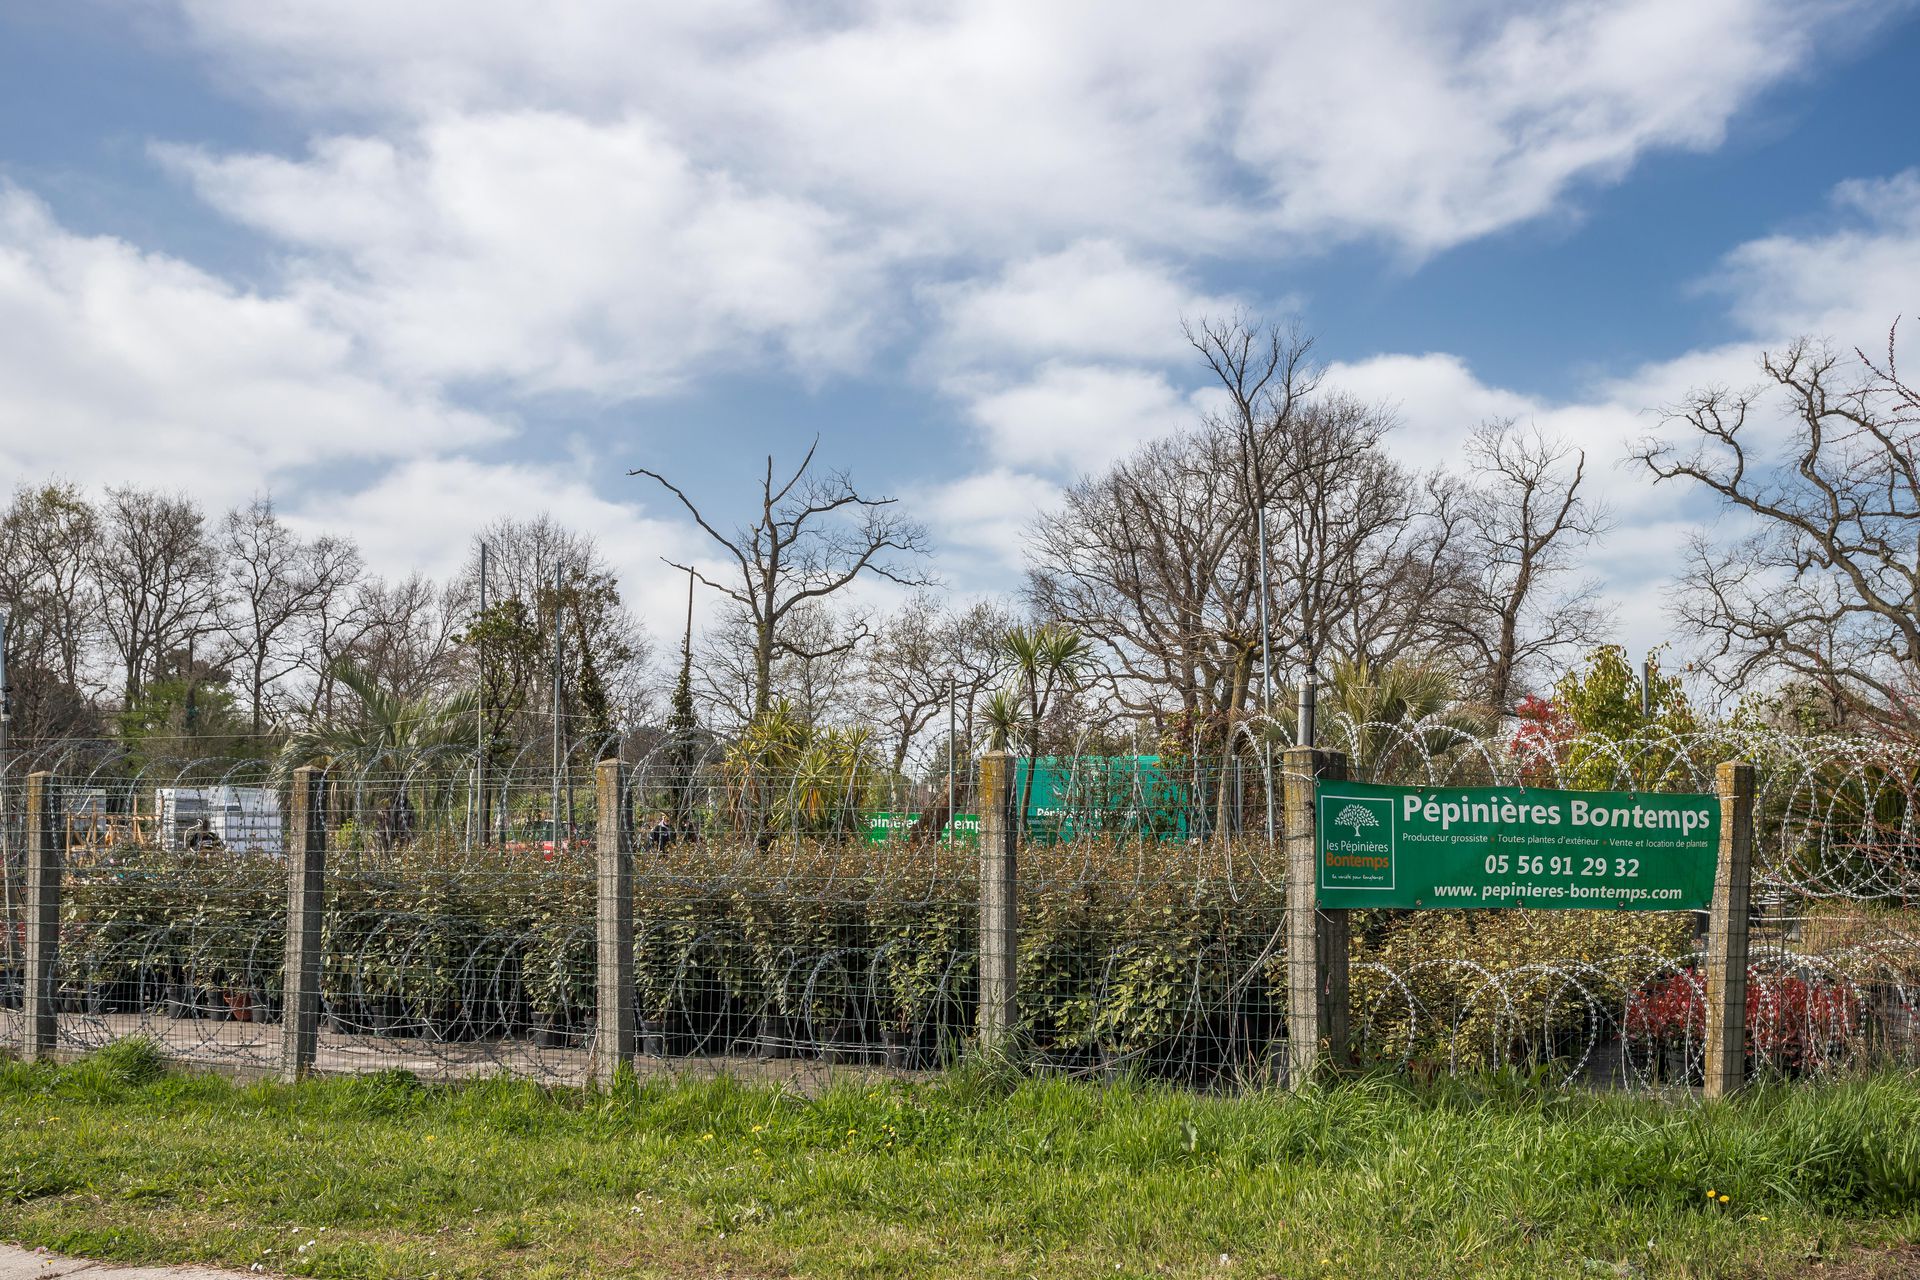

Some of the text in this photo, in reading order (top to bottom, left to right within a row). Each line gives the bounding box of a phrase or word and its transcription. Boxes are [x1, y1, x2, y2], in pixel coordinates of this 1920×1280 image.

[1403, 795, 1710, 836] Pépinières Bontemps
[1326, 839, 1389, 854] les Pépinières
[1402, 832, 1708, 850] Producteur grossiste Toutes plantes d'extérieur Vente et location de plantes
[1325, 851, 1390, 871] Bontemps
[1484, 854, 1640, 877] 05 56 91 29 32
[1433, 881, 1683, 902] www. pepinieres-bontemps.com
